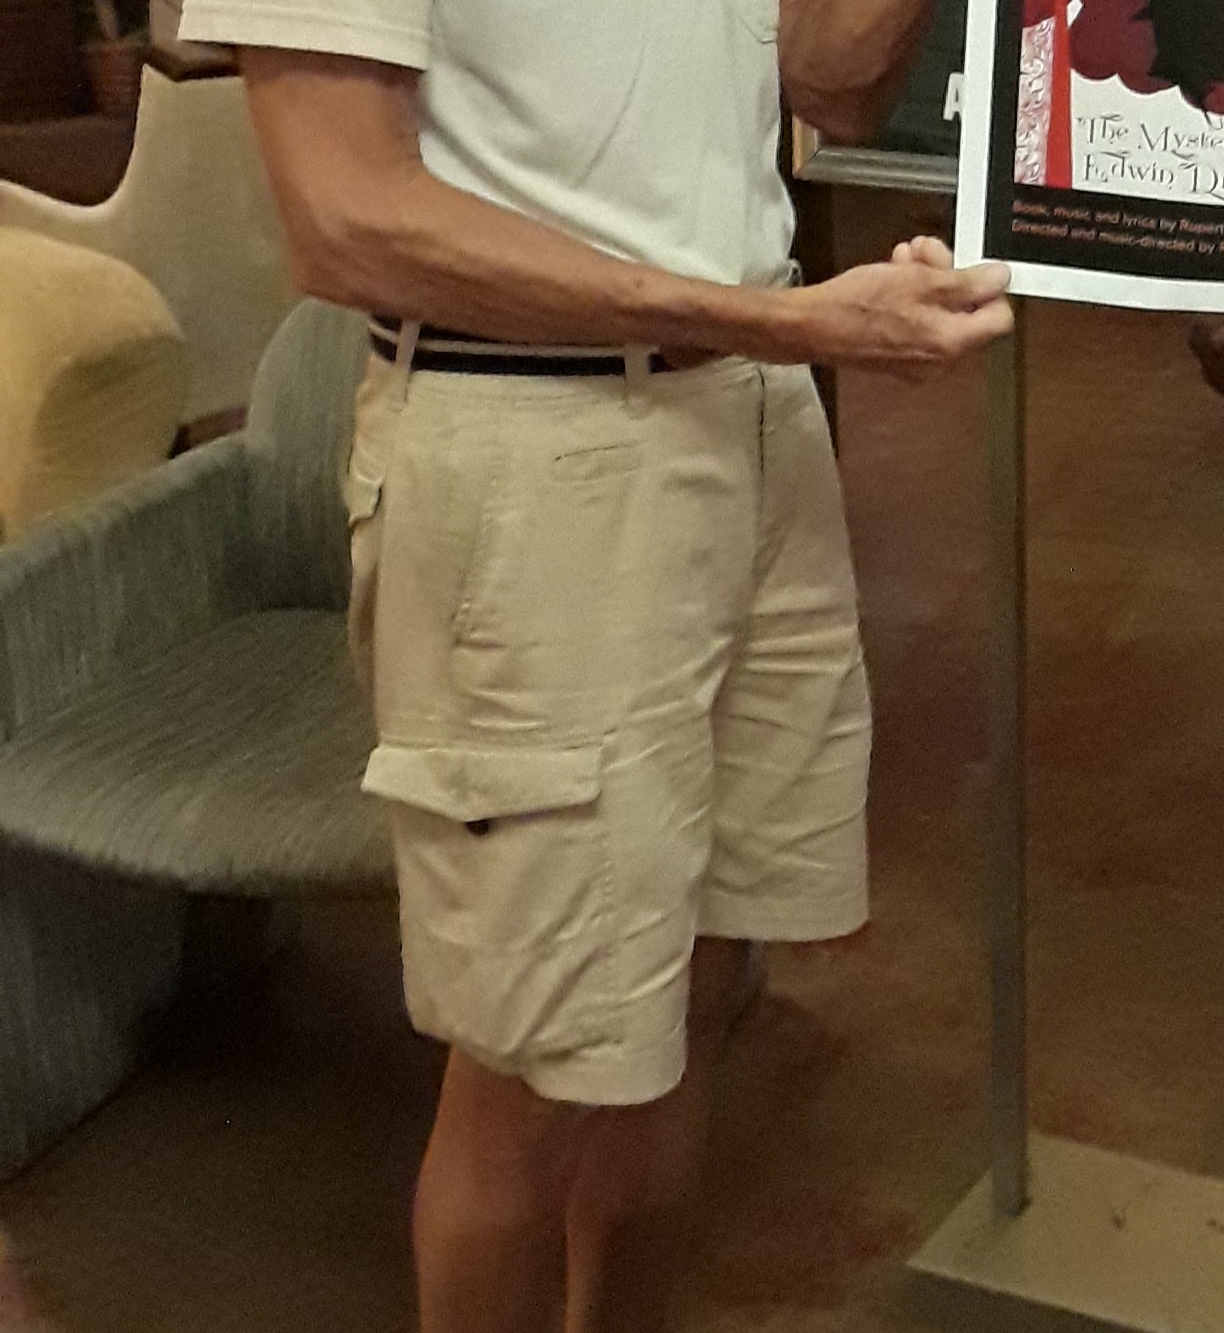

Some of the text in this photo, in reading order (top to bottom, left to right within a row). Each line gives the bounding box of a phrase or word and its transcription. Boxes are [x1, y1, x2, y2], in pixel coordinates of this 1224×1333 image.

[1076, 113, 1130, 144] The
[1084, 151, 1175, 190] Edwin
[1095, 211, 1121, 225] and
[1122, 214, 1156, 229] lyrics
[1159, 218, 1177, 233] by
[1070, 226, 1097, 241] and
[1197, 239, 1217, 255] by
